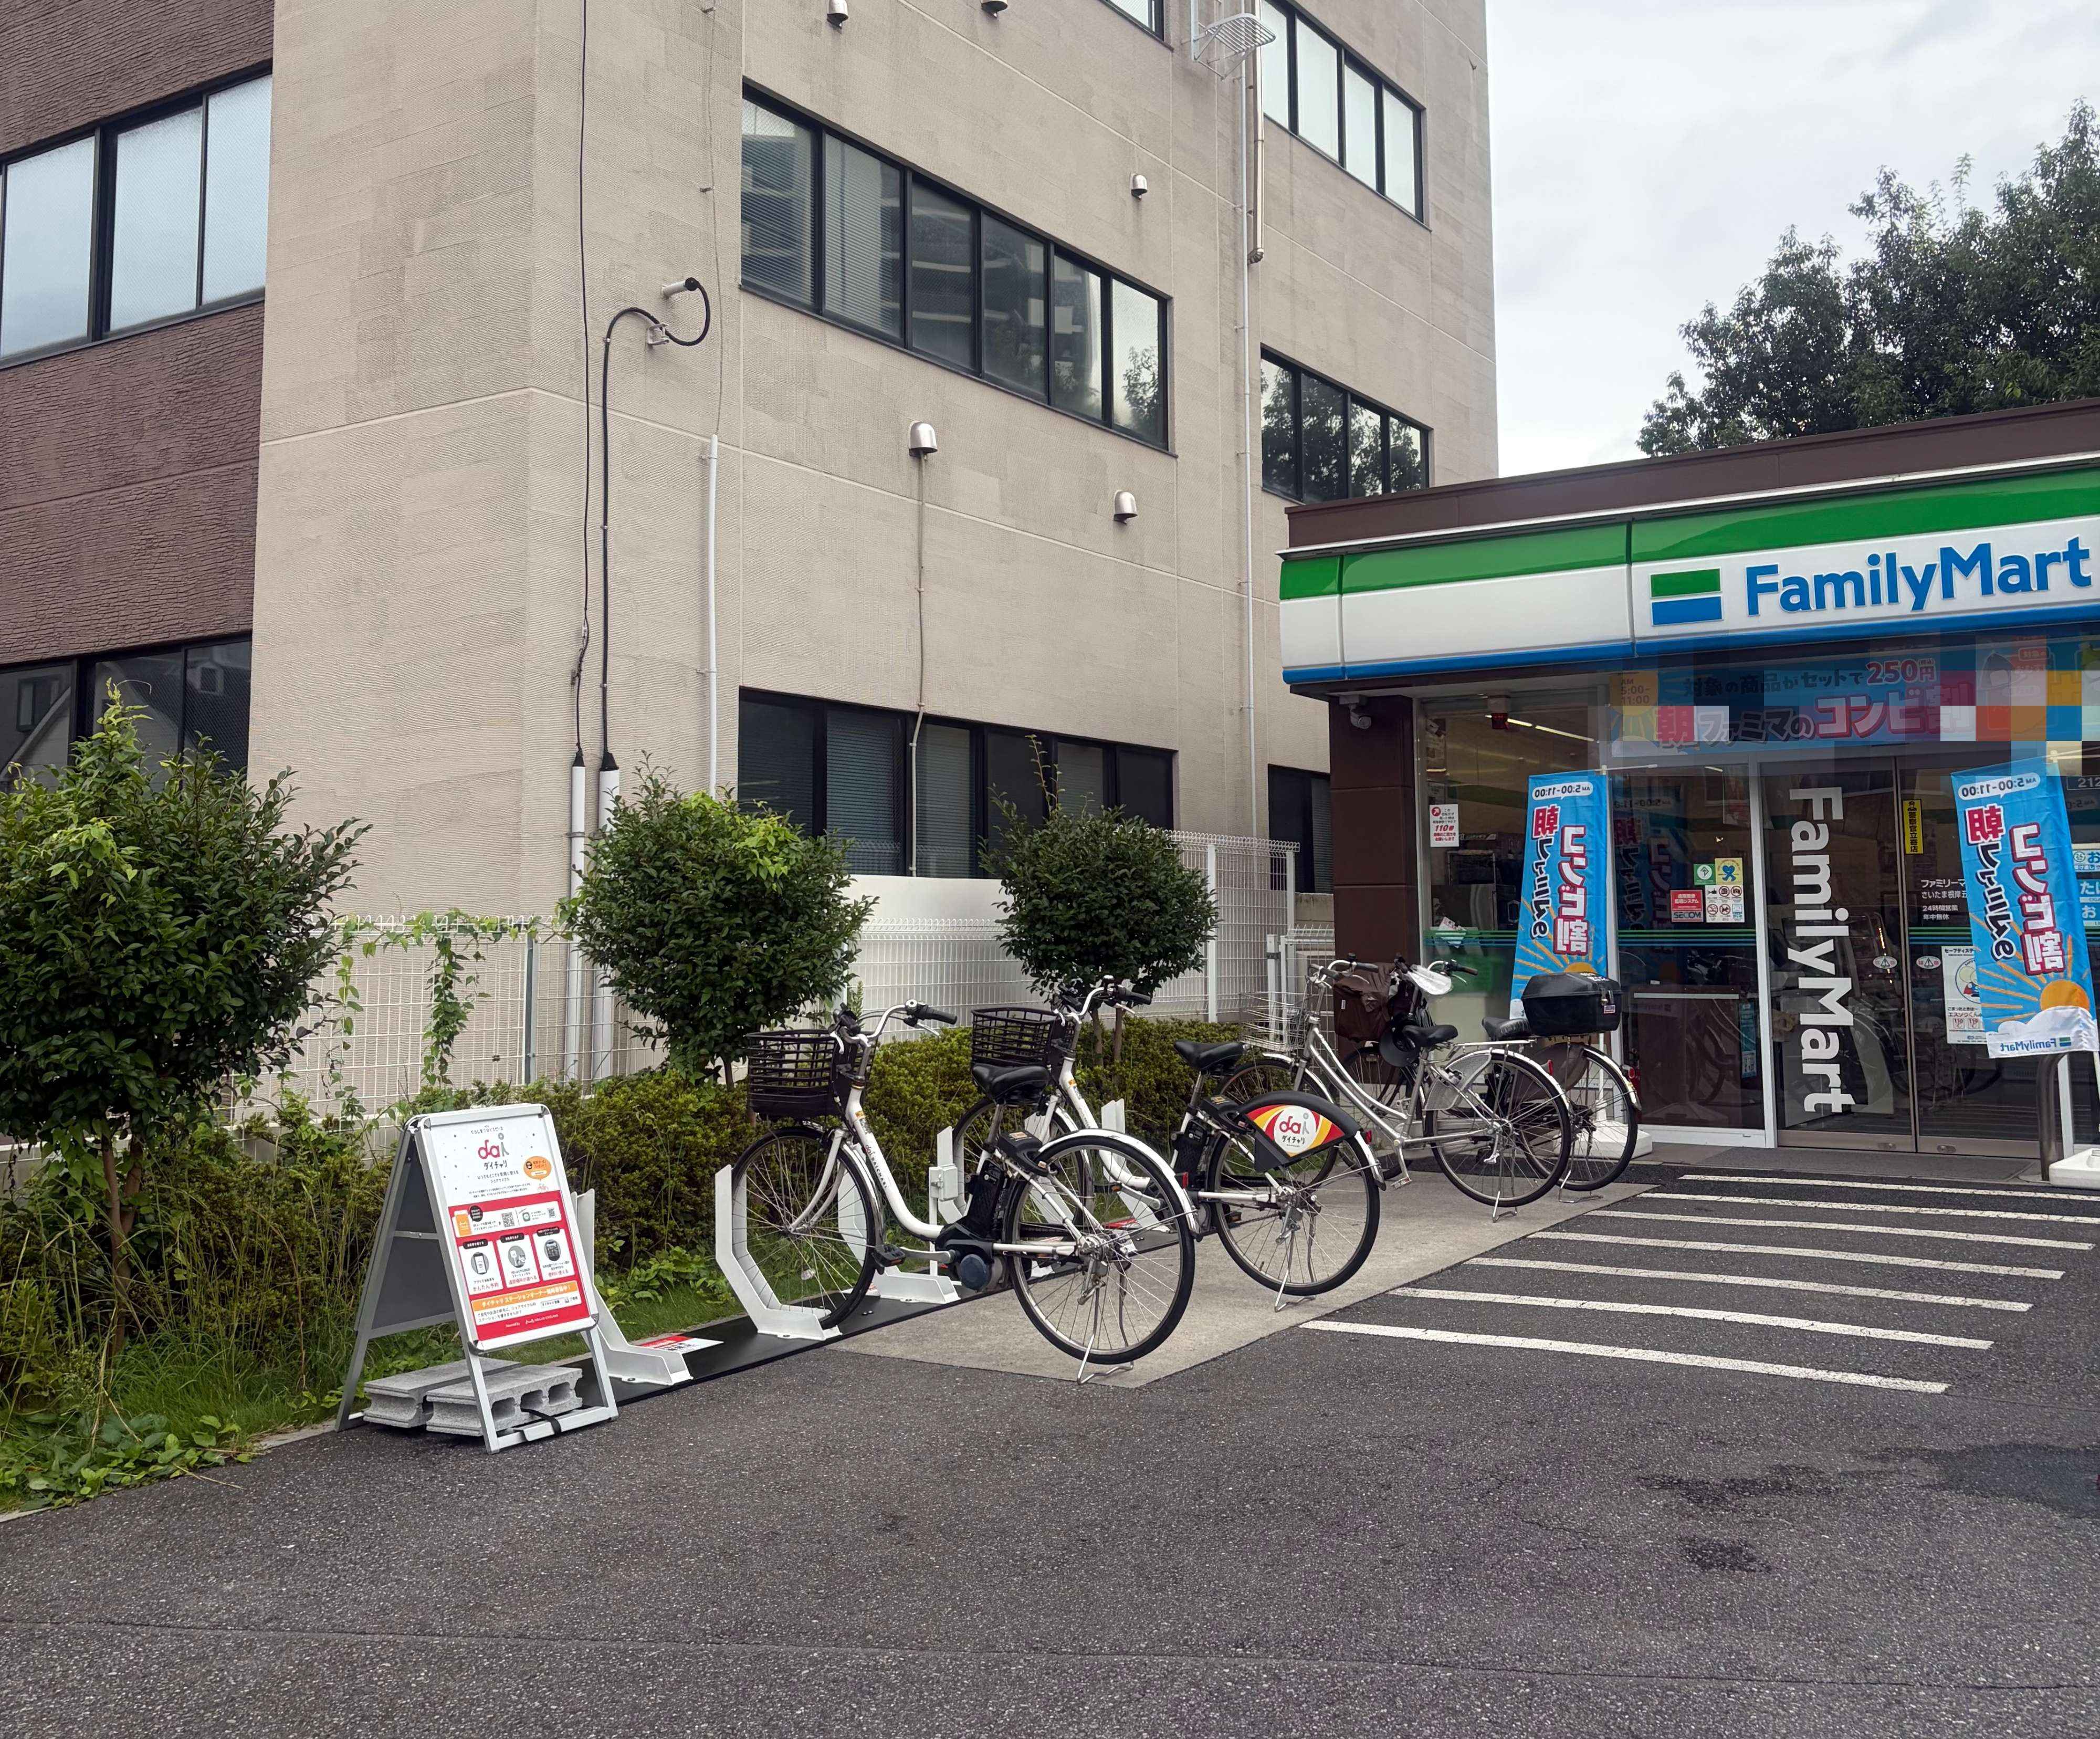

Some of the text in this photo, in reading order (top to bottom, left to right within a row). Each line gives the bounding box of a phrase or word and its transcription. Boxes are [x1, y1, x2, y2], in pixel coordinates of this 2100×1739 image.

[1745, 536, 2092, 616] FamilyMart
[1621, 695, 1650, 705] 11:00
[1920, 878, 1965, 888] ファミリーマ
[1787, 787, 1856, 1113] FamilyMart
[1279, 1112, 1309, 1135] dai
[478, 1132, 509, 1160] dai
[1282, 1135, 1305, 1145] ダイチャリ
[484, 1159, 508, 1170] ダイチャリ
